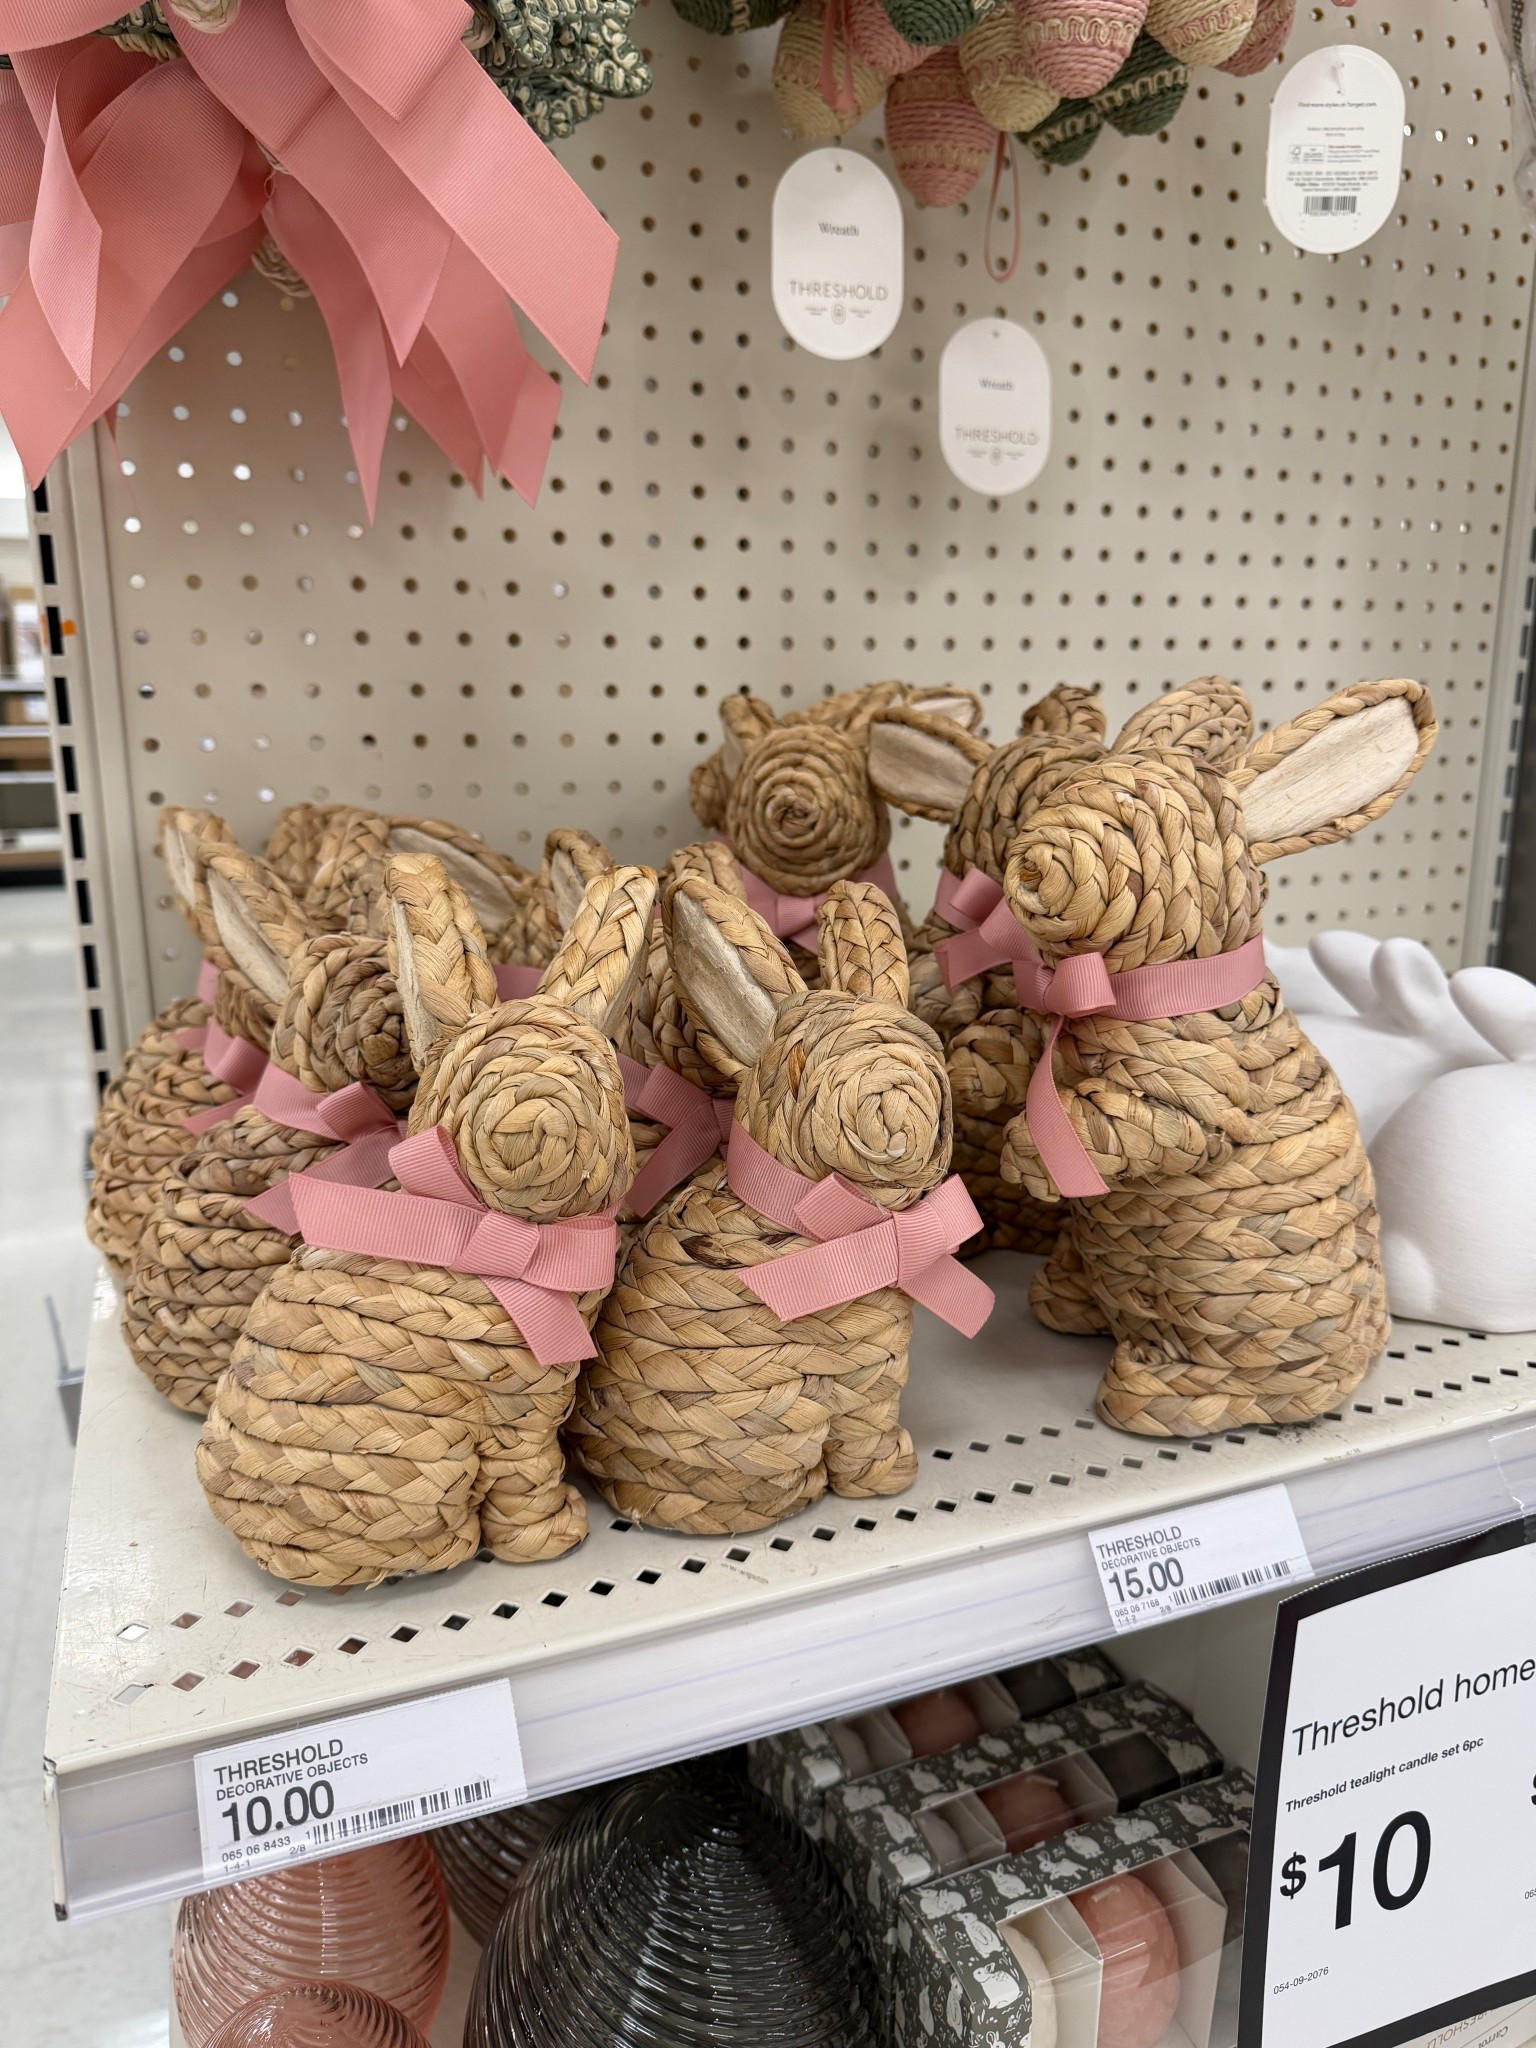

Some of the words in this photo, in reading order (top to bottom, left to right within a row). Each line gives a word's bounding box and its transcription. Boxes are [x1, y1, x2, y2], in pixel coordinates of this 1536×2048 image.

[818, 222, 860, 237] Wreath
[790, 281, 889, 301] THRESHOLD
[979, 378, 1015, 392] Wreath
[955, 428, 1039, 446] THRESHOLD
[1096, 1526, 1182, 1559] THRESHOLD
[1101, 1549, 1158, 1571] DECORATIVE
[1160, 1537, 1201, 1556] OBJECTS
[1108, 1557, 1184, 1602] 15.00
[1114, 1607, 1129, 1617] 065
[1292, 1678, 1444, 1756] Threshold
[1454, 1658, 1536, 1702] home
[214, 1739, 344, 1785] THRESHOLD
[216, 1769, 303, 1801] DECORATIVE
[307, 1753, 368, 1778] OBJECTS
[1286, 1781, 1347, 1813] Threshold
[1350, 1765, 1396, 1790] tealight
[1399, 1752, 1438, 1773] candle
[1441, 1744, 1460, 1758] set
[1462, 1737, 1484, 1754] 6pc
[222, 1780, 334, 1841] 10.00
[222, 1849, 242, 1862] 065
[246, 1844, 260, 1856] 06
[263, 1836, 291, 1851] 8433
[289, 1844, 306, 1855] 2/8
[223, 1859, 251, 1873] 1-4-1
[1279, 1810, 1431, 1930] $10
[1273, 1966, 1329, 1995] 054-09-2076
